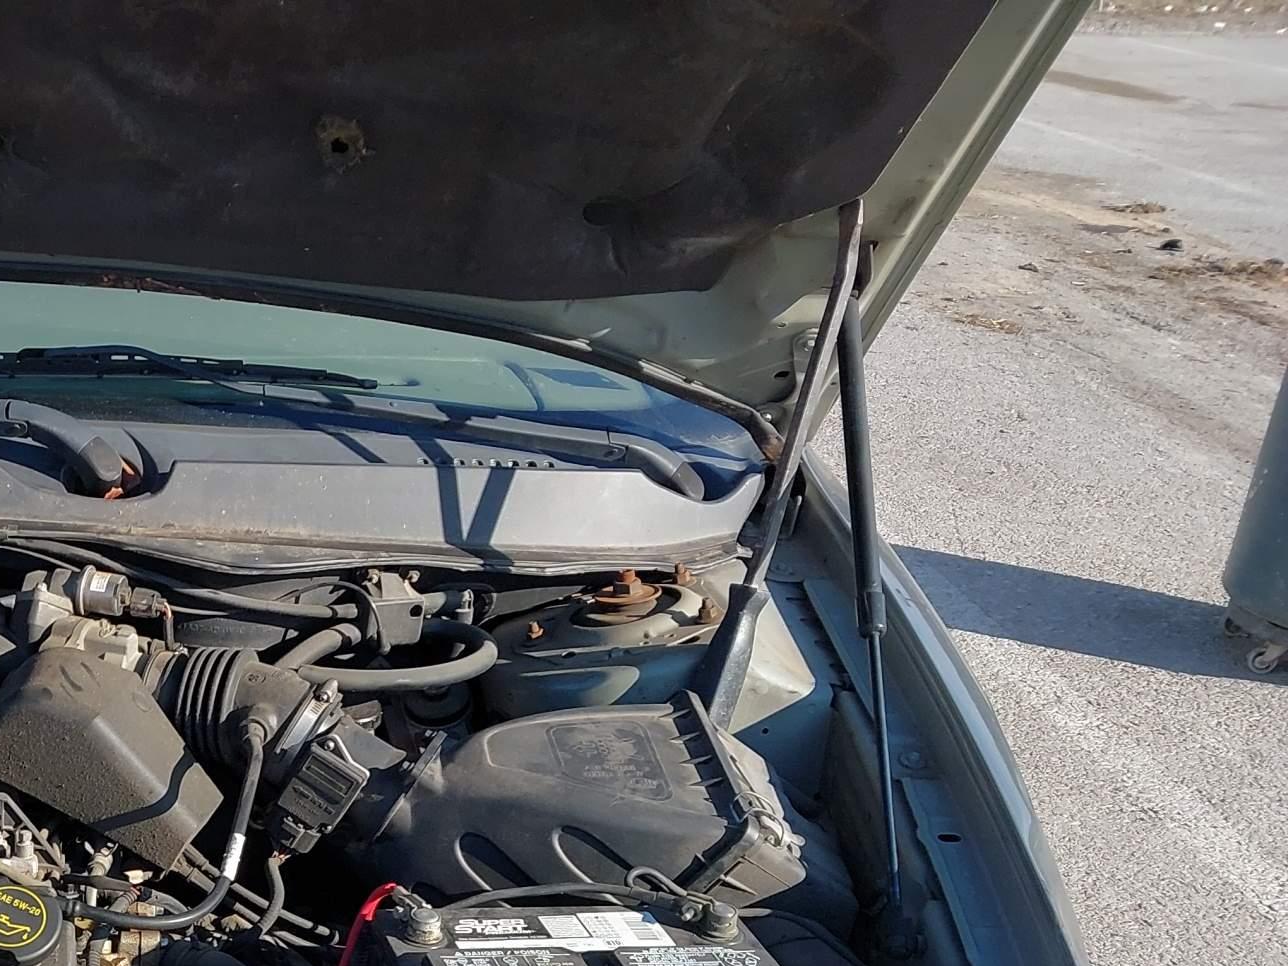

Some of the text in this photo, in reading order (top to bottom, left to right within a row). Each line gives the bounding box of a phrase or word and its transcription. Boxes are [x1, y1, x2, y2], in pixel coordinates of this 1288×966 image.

[12, 898, 41, 916] 5W-20
[458, 918, 525, 926] SUPER
[454, 924, 528, 934] START
